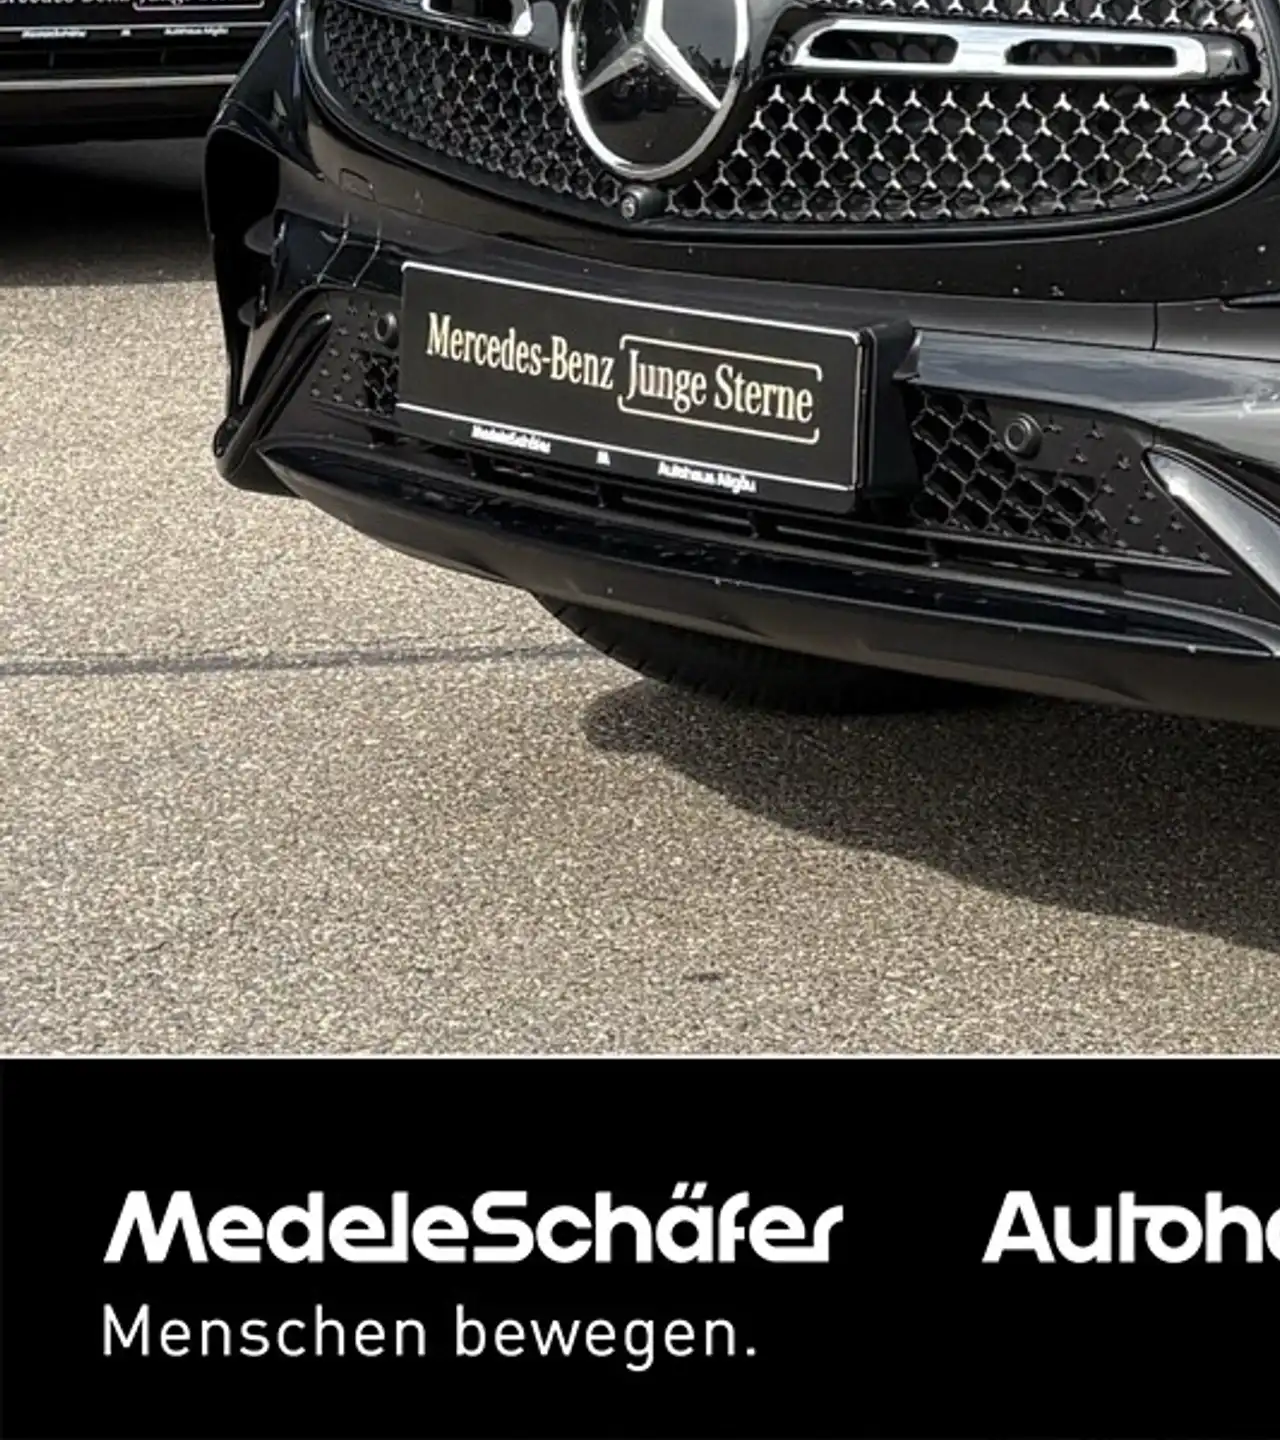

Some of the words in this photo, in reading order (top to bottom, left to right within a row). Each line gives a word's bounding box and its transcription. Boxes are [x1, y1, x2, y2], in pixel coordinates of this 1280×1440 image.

[426, 312, 615, 391] Mercedes-Benz
[626, 348, 708, 414] Junge
[714, 363, 814, 423] Sterne
